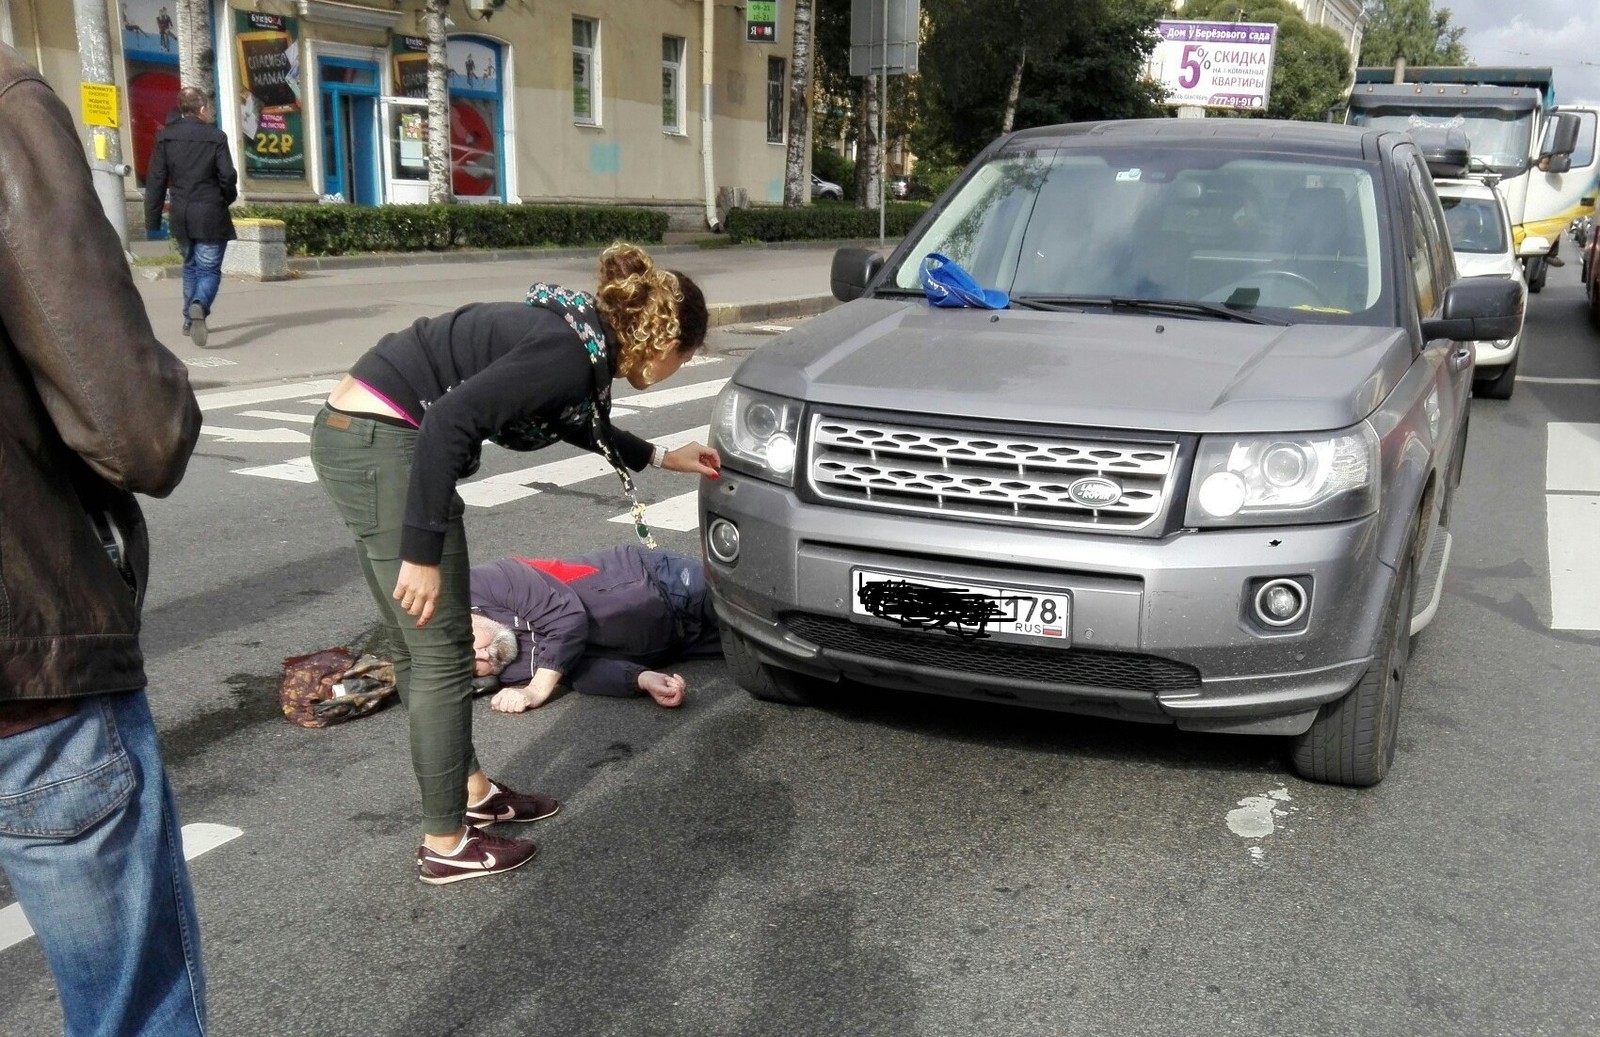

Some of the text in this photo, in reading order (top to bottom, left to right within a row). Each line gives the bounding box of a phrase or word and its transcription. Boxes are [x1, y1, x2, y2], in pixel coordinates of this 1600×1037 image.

[1167, 27, 1271, 42] Дом у Берёзового сада
[247, 51, 287, 70] СПАСИБО
[1214, 49, 1266, 67] СКИДКА
[1211, 76, 1264, 88] КВАРТИРЫ
[1213, 96, 1252, 106] 777-91-91
[1005, 598, 1057, 625] 178
[1015, 622, 1042, 634] RUS
